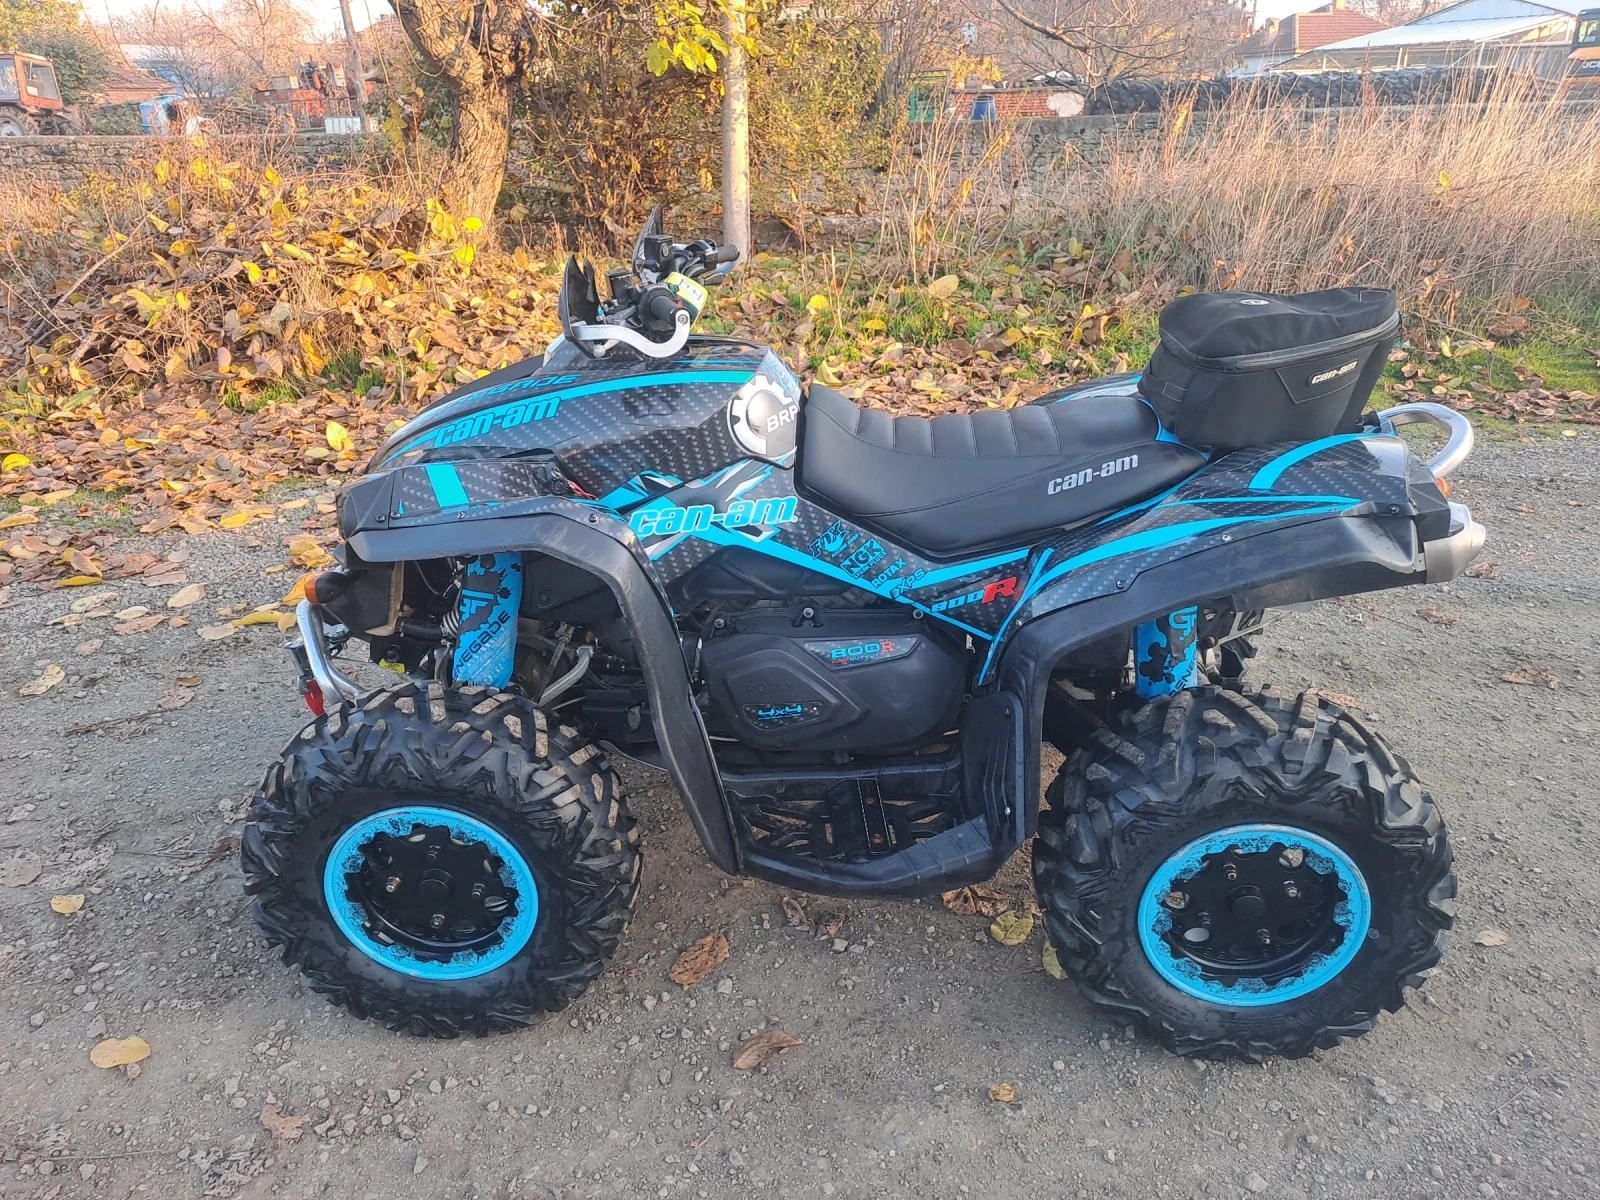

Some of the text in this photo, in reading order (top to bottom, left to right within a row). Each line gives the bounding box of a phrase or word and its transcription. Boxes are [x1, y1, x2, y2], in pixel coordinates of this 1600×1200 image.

[1311, 361, 1357, 384] can-am
[434, 397, 560, 449] can-am
[766, 404, 798, 433] BRP
[1047, 454, 1138, 495] can-am
[629, 496, 797, 537] can-am
[842, 540, 882, 575] NGK
[870, 557, 906, 588] ROTAX
[931, 576, 1017, 613] 800R
[830, 641, 895, 659] 800R
